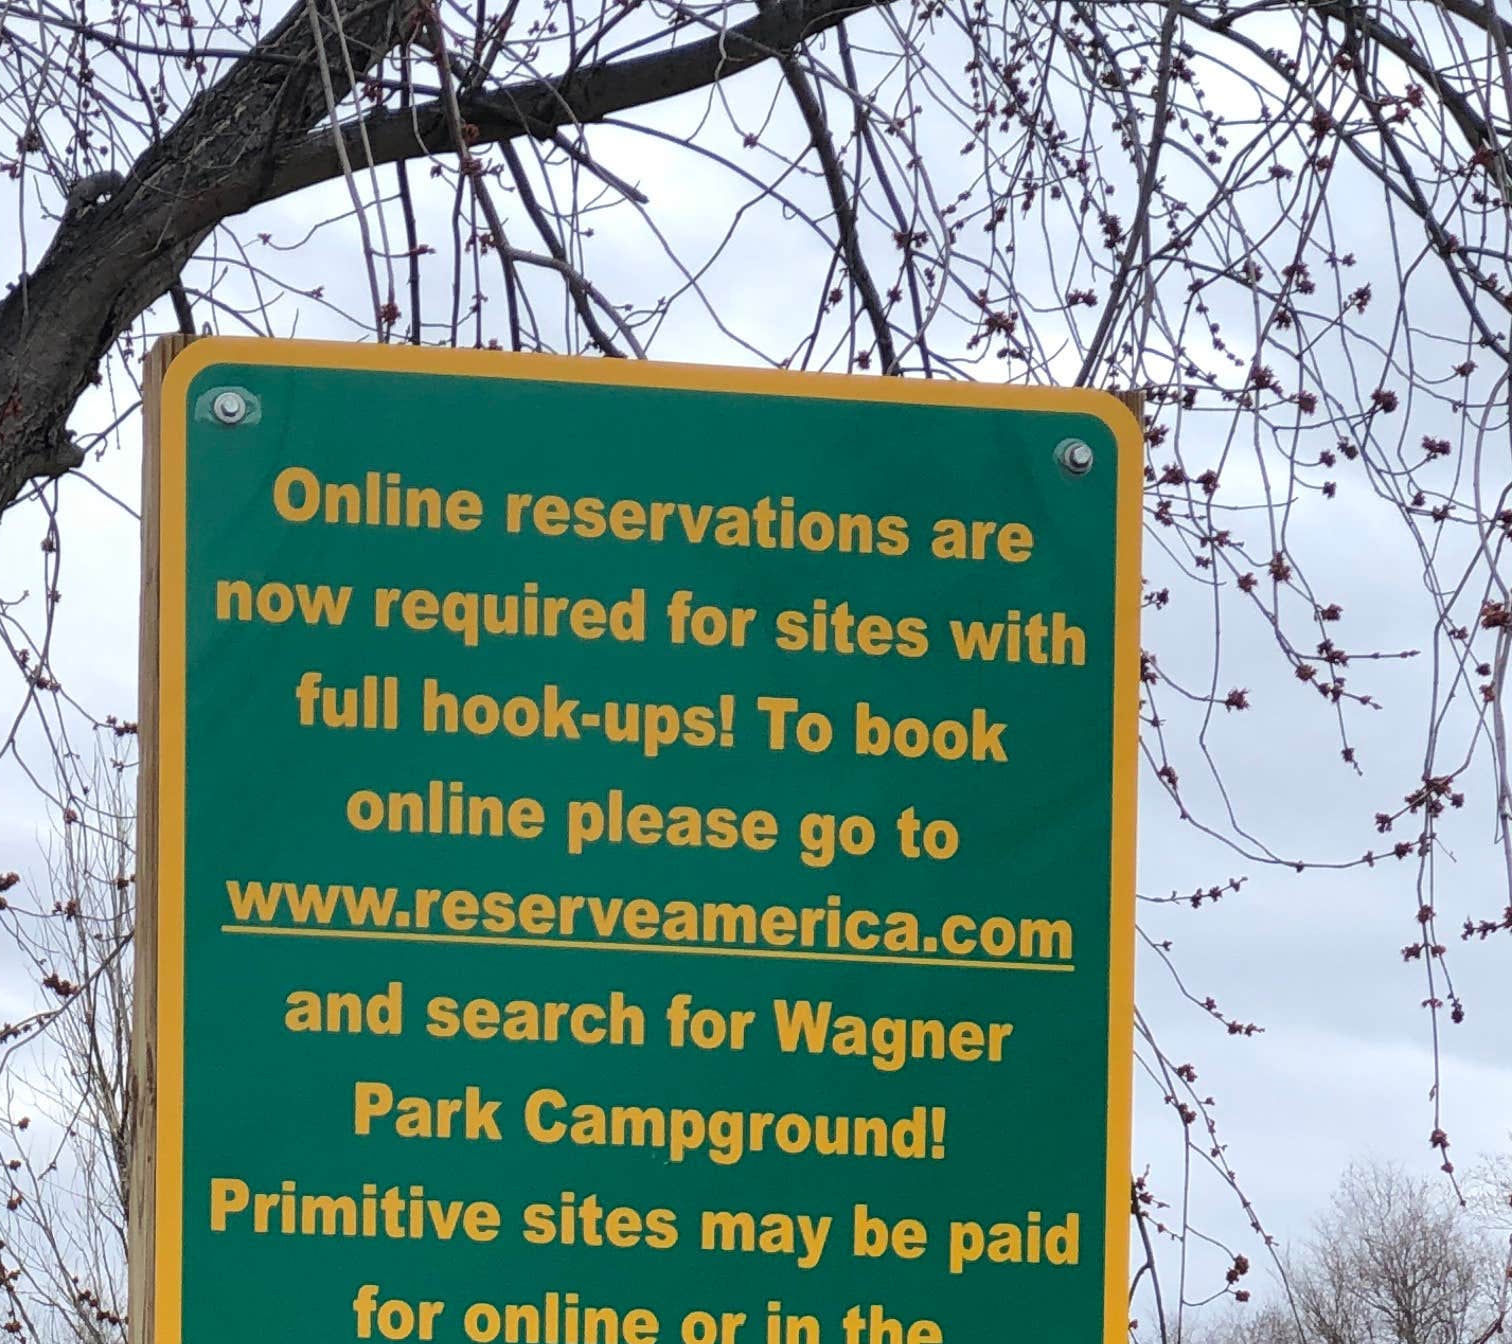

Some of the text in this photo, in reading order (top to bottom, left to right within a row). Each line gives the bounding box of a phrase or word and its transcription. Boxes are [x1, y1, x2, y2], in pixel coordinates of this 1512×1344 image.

[274, 467, 1033, 562] Online reservations are
[217, 581, 1085, 665] now required for sites with
[296, 672, 1007, 761] full hook-ups! To book
[347, 781, 958, 867] online please go to
[227, 879, 1073, 960] www.reserveamerica.com
[285, 982, 1013, 1071] and search for Wagner
[355, 1082, 945, 1165] Park Campground!
[211, 1178, 1079, 1274] Primitive sites may be paid
[353, 1285, 444, 1340] for
